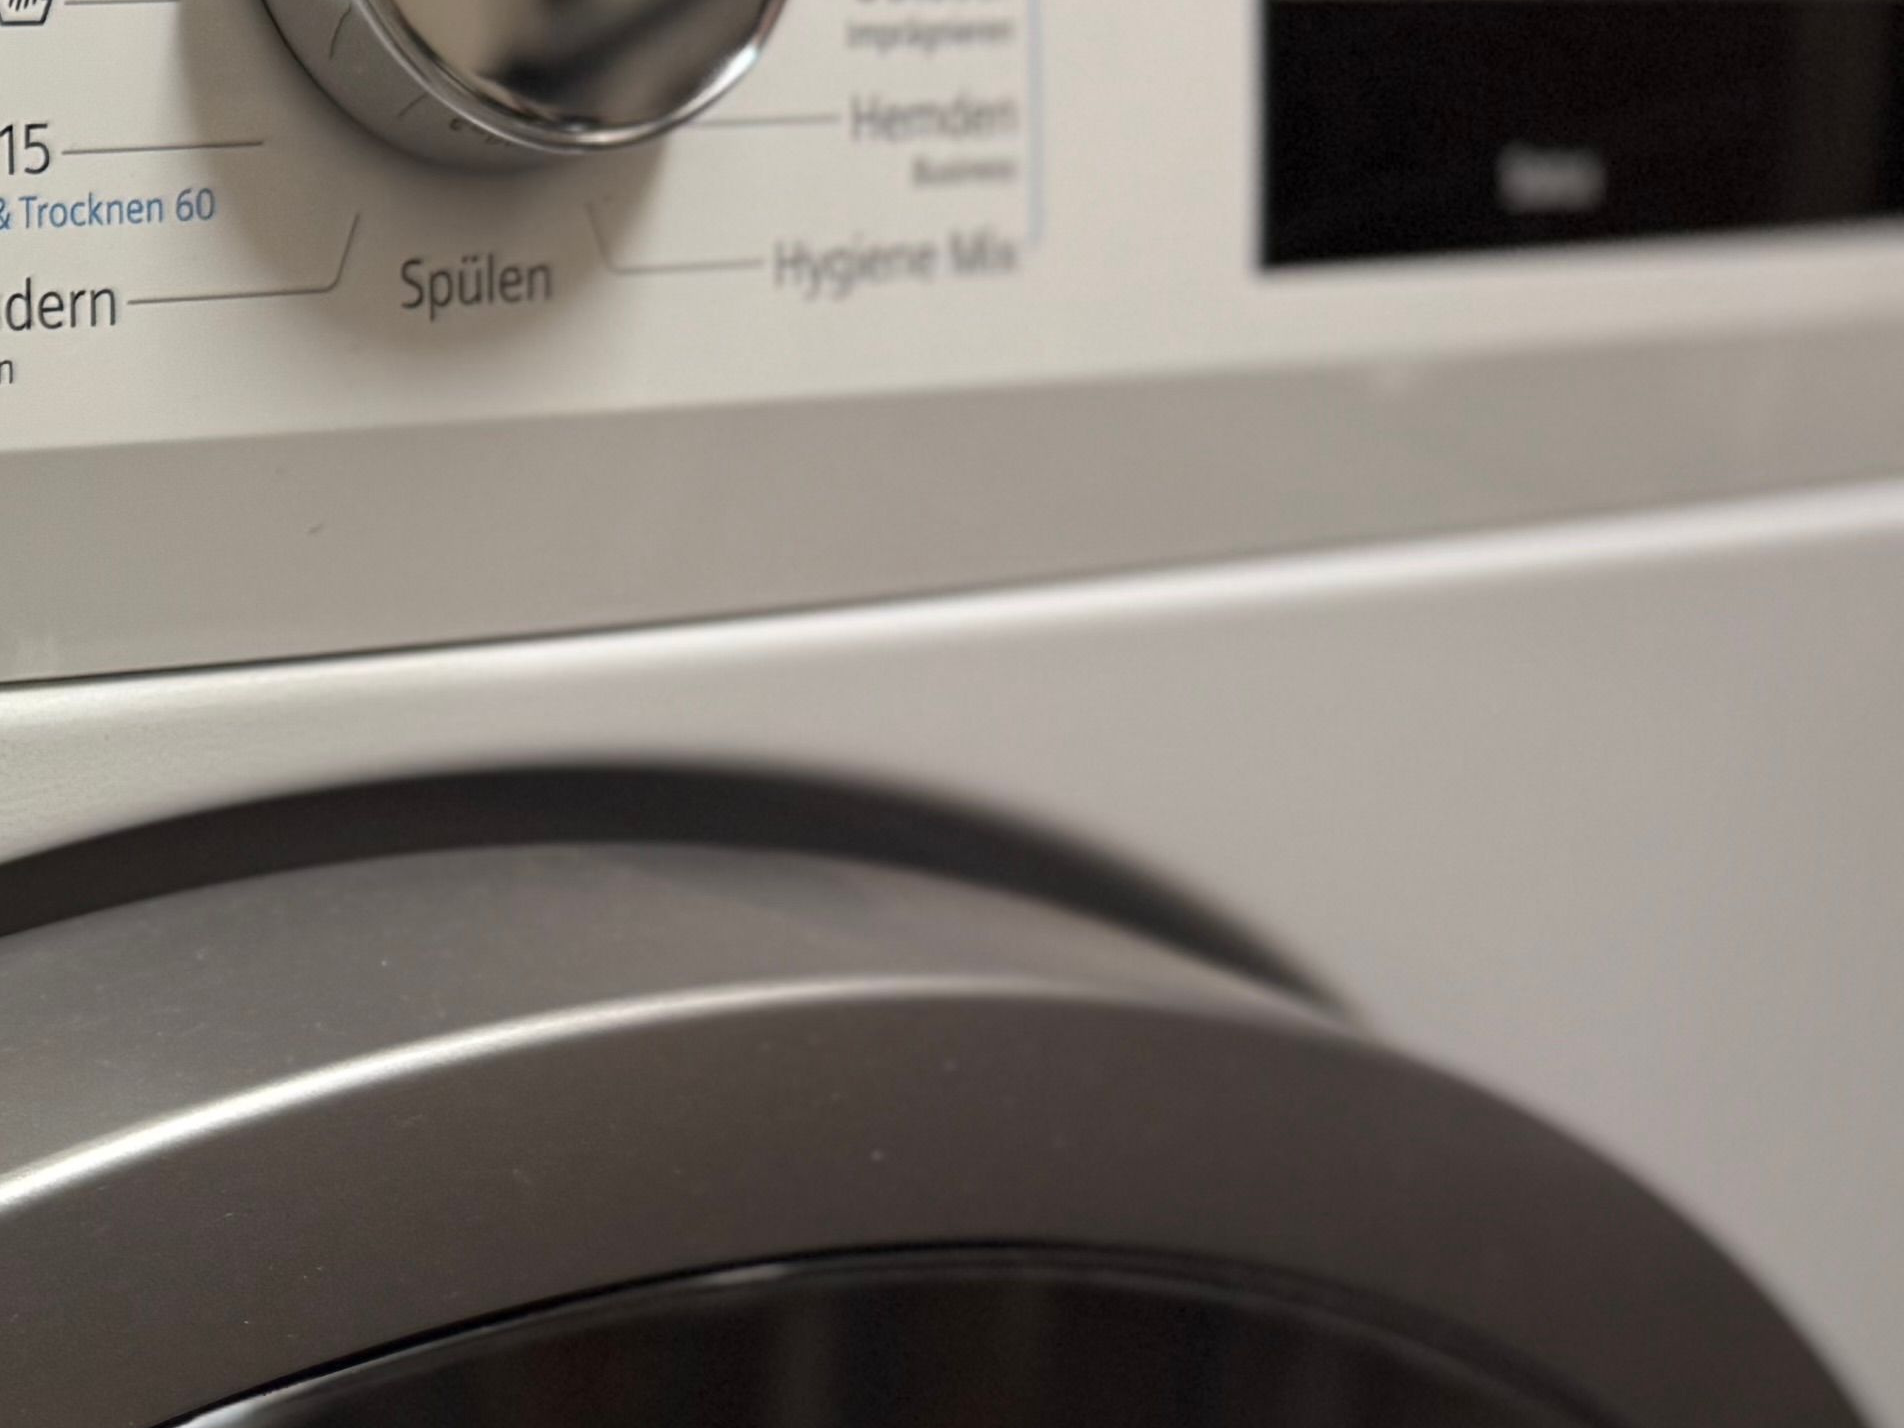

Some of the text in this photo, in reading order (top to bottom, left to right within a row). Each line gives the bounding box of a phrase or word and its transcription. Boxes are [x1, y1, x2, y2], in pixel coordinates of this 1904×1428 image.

[849, 93, 1019, 142] Hemden
[21, 191, 165, 229] Trocknen
[175, 188, 216, 222] 60
[399, 254, 553, 322] Spülen
[774, 232, 1019, 300] Hygiene Mix
